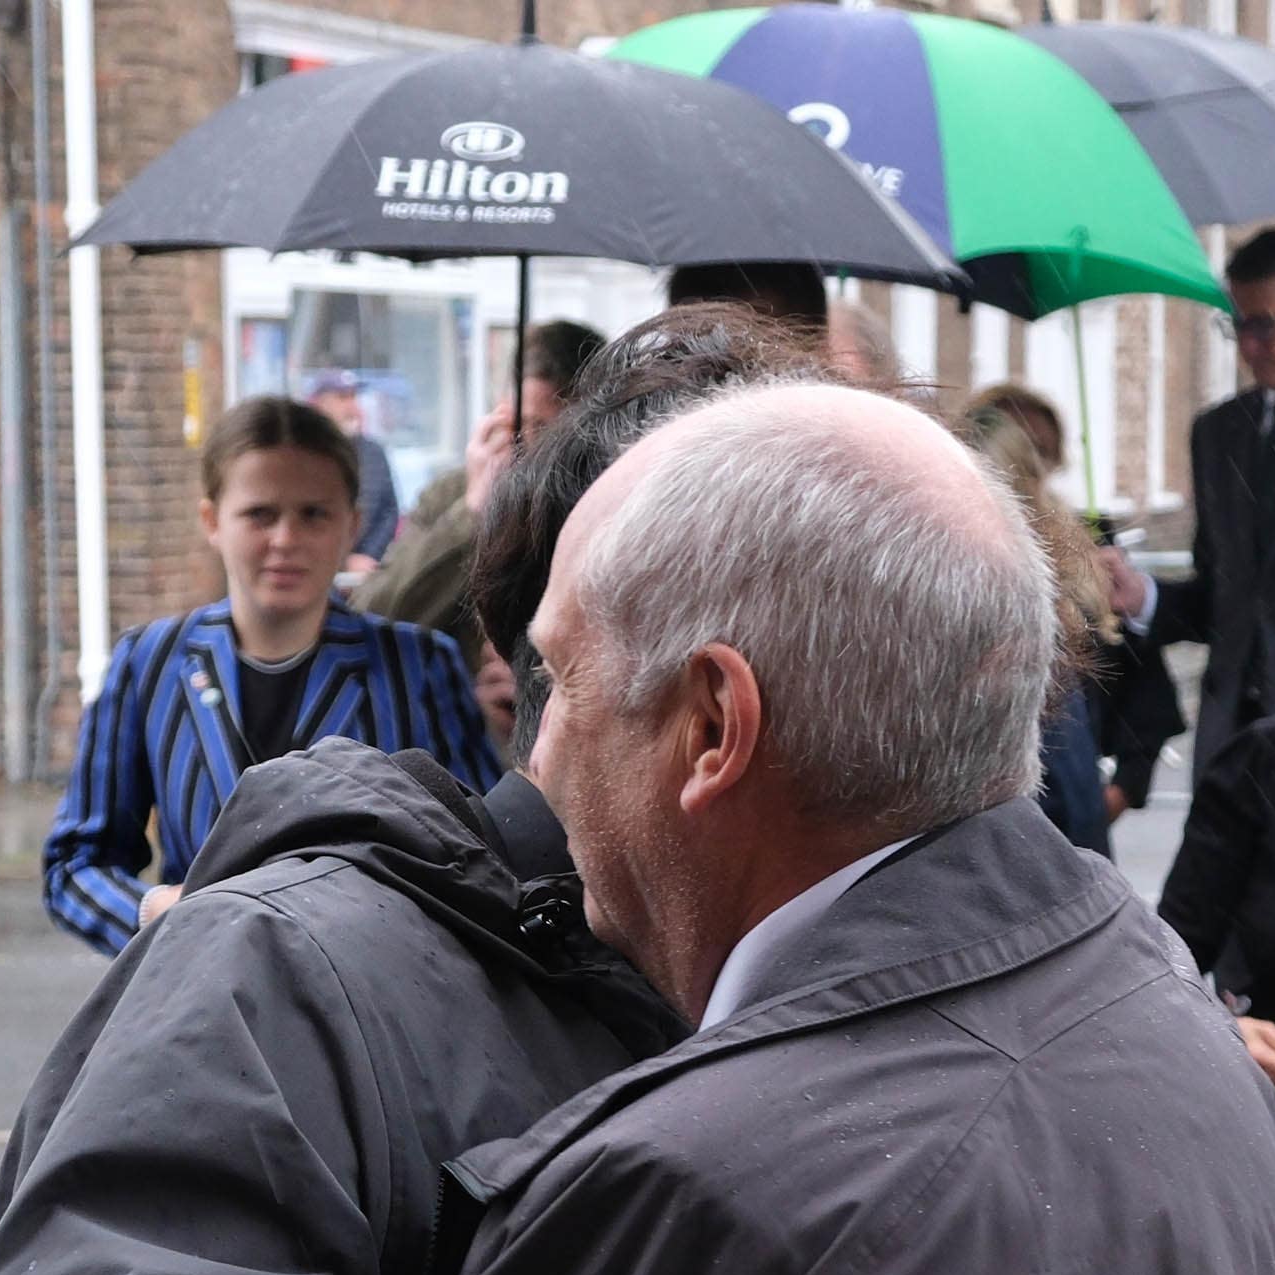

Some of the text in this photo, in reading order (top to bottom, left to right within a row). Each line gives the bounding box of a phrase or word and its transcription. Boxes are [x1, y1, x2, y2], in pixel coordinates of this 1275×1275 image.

[375, 156, 570, 203] Hilton
[381, 201, 557, 225] HOTELS & RESORTS
